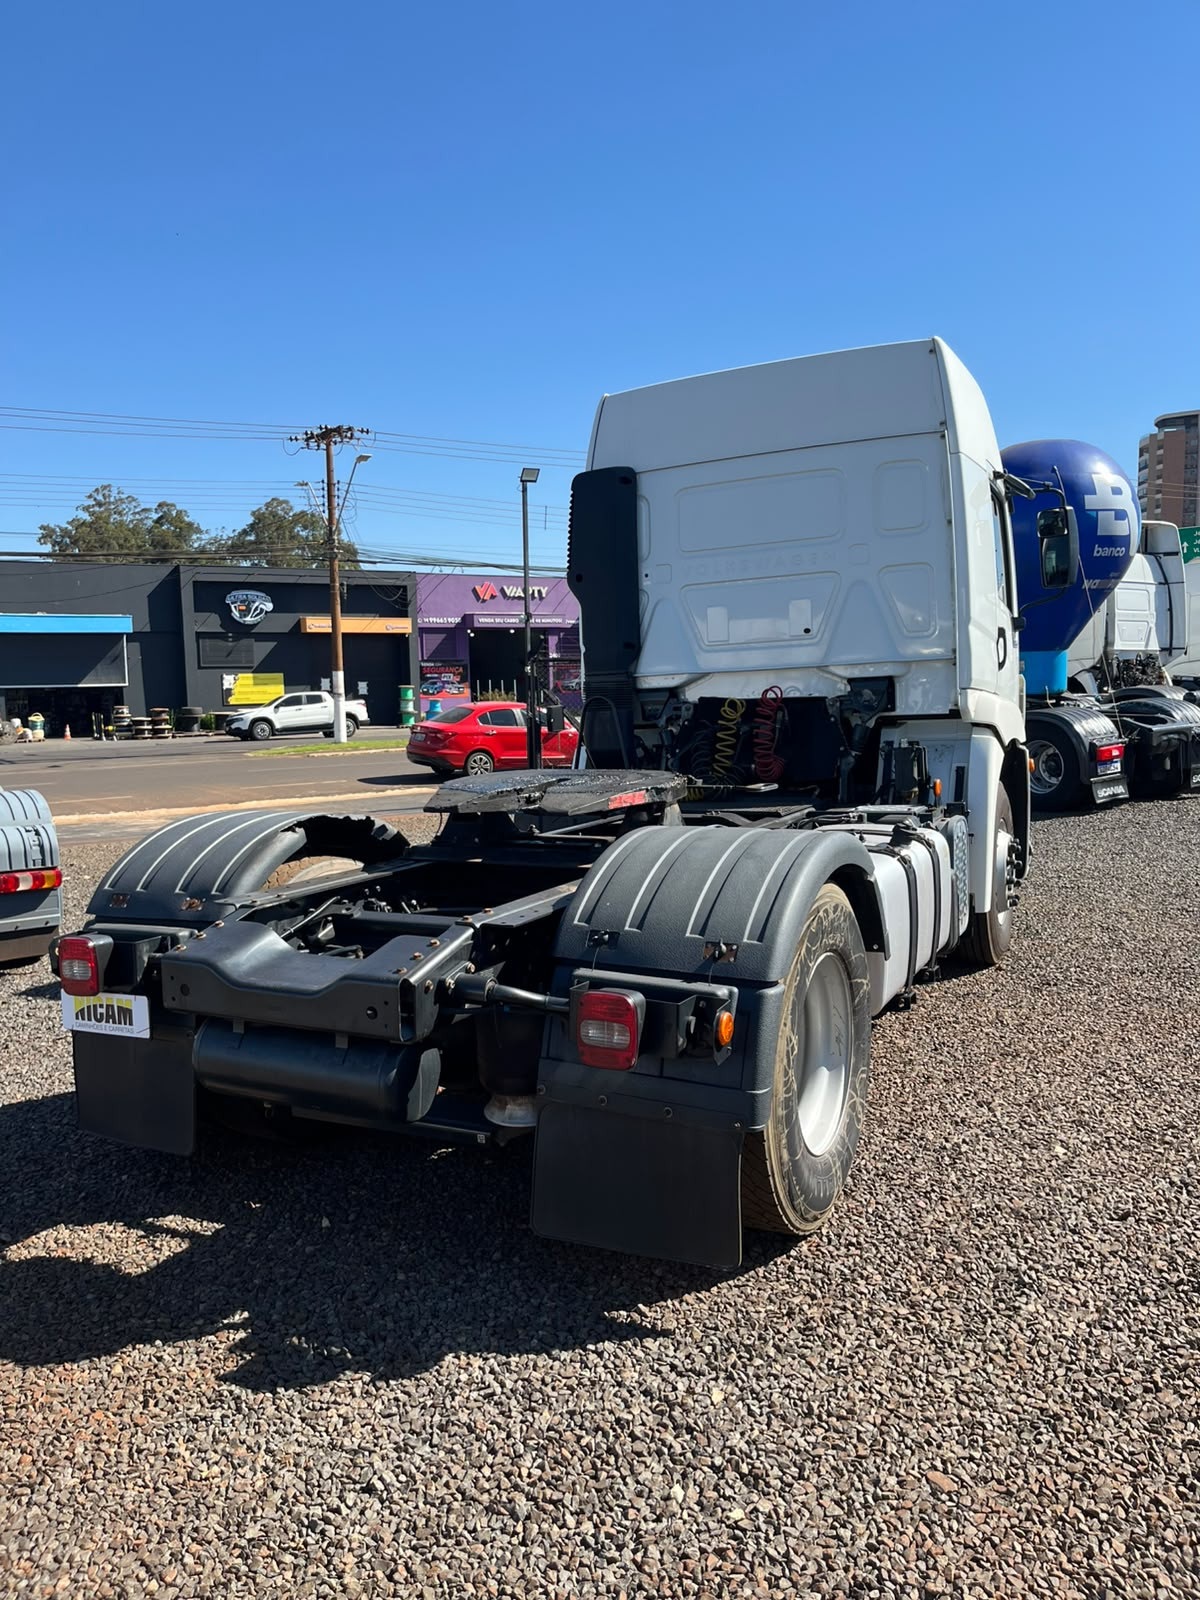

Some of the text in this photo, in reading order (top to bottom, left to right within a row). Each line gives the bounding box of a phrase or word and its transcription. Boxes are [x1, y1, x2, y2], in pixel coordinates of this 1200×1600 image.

[1093, 544, 1126, 557] banco
[1097, 785, 1125, 798] SCANIA
[74, 996, 134, 1027] NICAM
